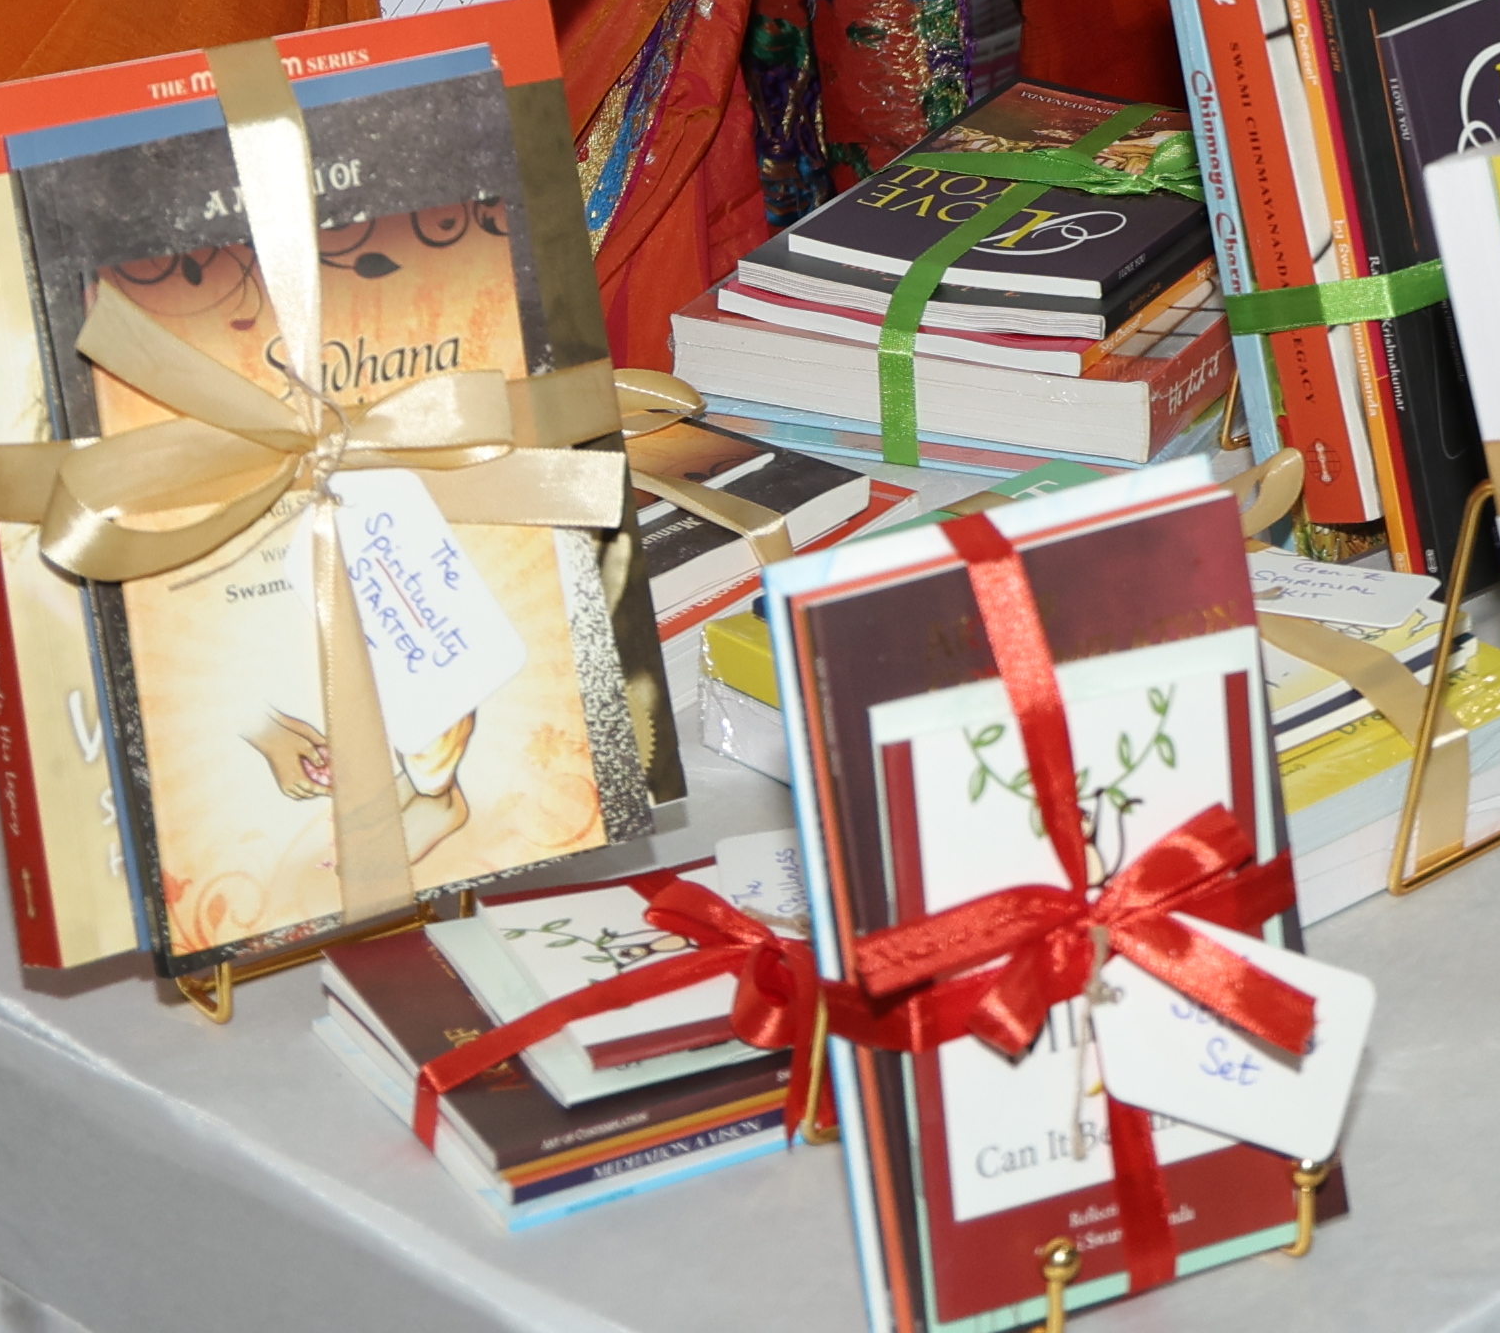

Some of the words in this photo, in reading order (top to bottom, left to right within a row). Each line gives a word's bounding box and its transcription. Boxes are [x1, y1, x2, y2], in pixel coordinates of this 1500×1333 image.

[147, 78, 187, 100] THE
[306, 48, 370, 73] SERIES
[1190, 69, 1225, 201] Chinmaya
[1395, 117, 1412, 141] YOU
[204, 190, 229, 218] A
[328, 160, 363, 192] Of
[1229, 41, 1253, 108] SWAMI
[1245, 116, 1291, 290] CHINMAYANANDA
[1379, 317, 1405, 413] Krishnakumar
[361, 512, 470, 668] Spirituality
[430, 537, 461, 591] The
[347, 557, 427, 674] STARTER
[1199, 1035, 1265, 1089] Set
[591, 1140, 691, 1182] MEDITATION
[707, 1118, 763, 1151] VISION
[975, 1141, 1039, 1180] Can
[1047, 1129, 1069, 1162] It
